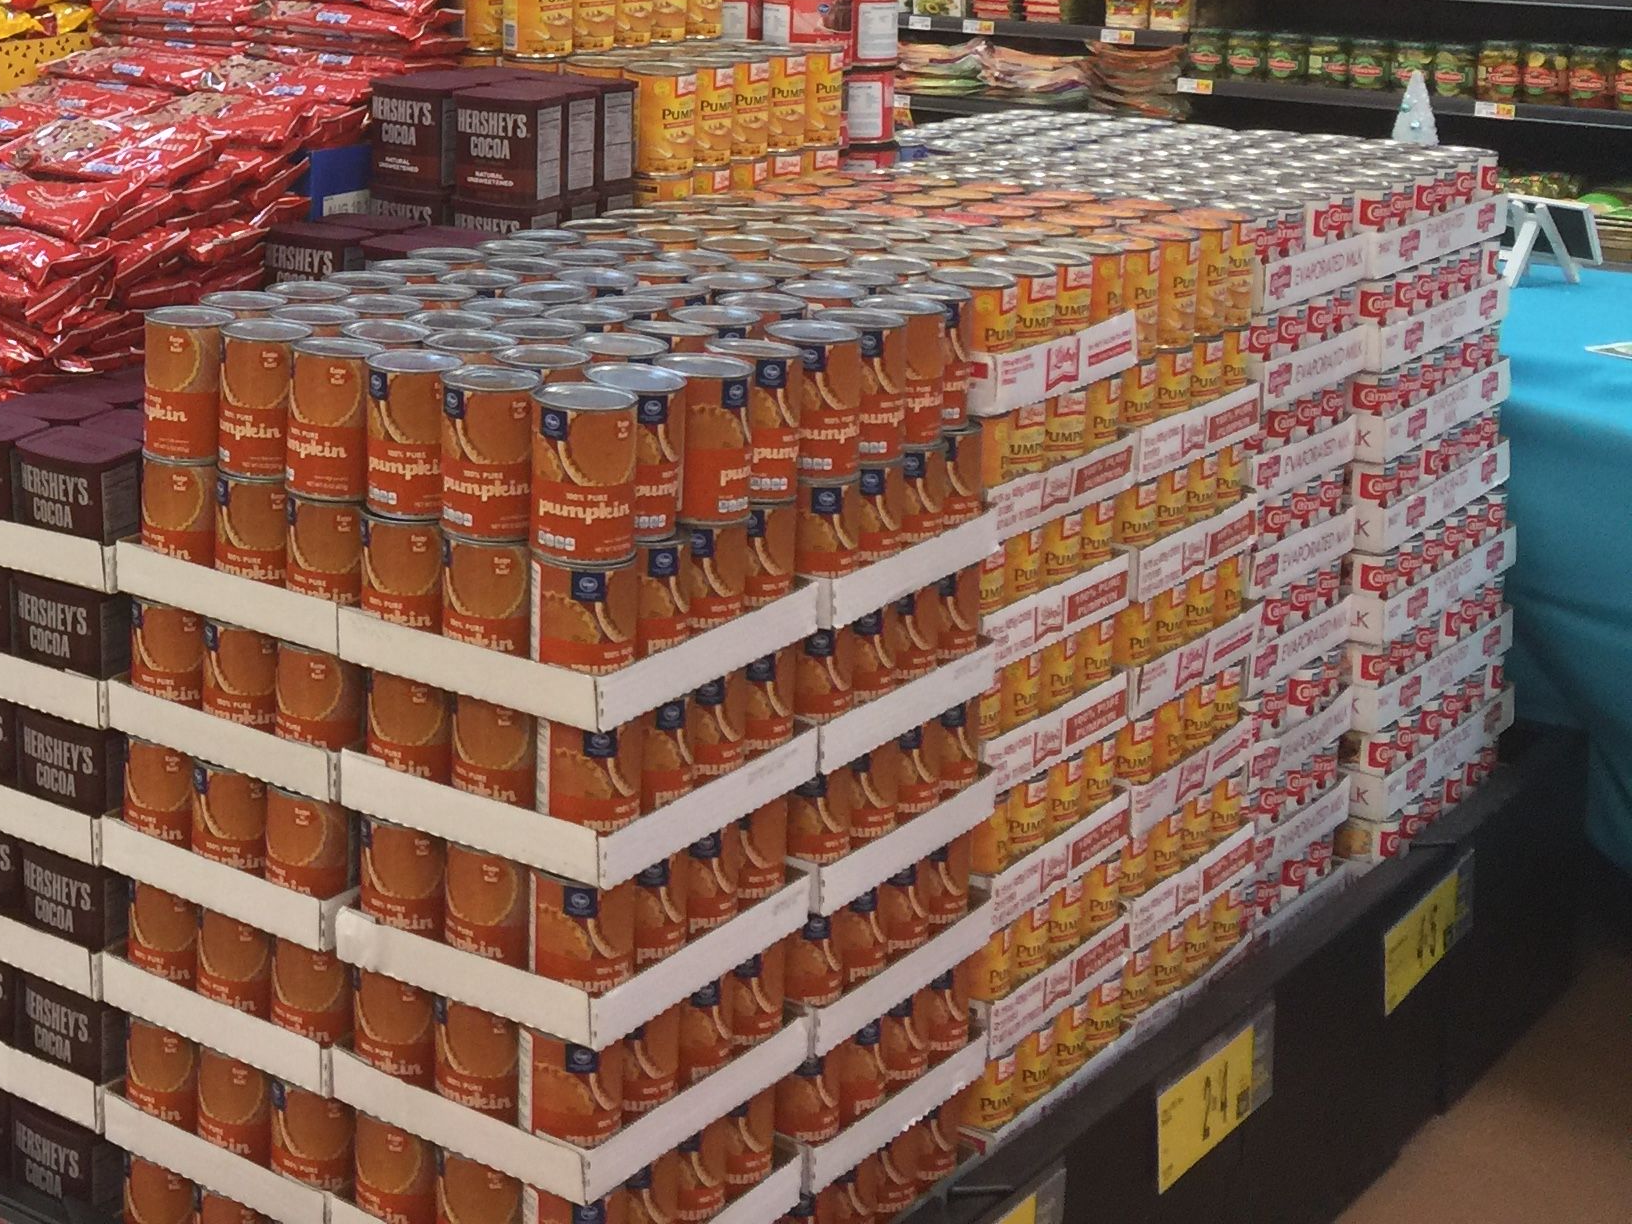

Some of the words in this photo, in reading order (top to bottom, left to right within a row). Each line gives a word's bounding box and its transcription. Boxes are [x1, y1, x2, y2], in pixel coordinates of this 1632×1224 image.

[372, 95, 433, 126] HERSHEY'S
[457, 107, 528, 139] HERSHEY'S
[381, 122, 417, 147] COCOA
[470, 135, 511, 160] COCOA
[368, 455, 442, 480] pumpki
[482, 471, 504, 480] PURE
[21, 465, 90, 506] HERSHEY'S
[443, 476, 530, 502] pumpkin
[586, 493, 608, 503] PURE
[33, 498, 73, 529] COCOA
[538, 498, 630, 525] pumpkin
[18, 590, 88, 636] HERSHEY'S
[29, 626, 71, 659] COCOA
[23, 725, 94, 776] HERSHEY'S
[36, 764, 77, 799] COCOA
[23, 858, 93, 912] HERSHEY'S
[34, 896, 75, 934] COCOA
[33, 1025, 72, 1065] COCOA
